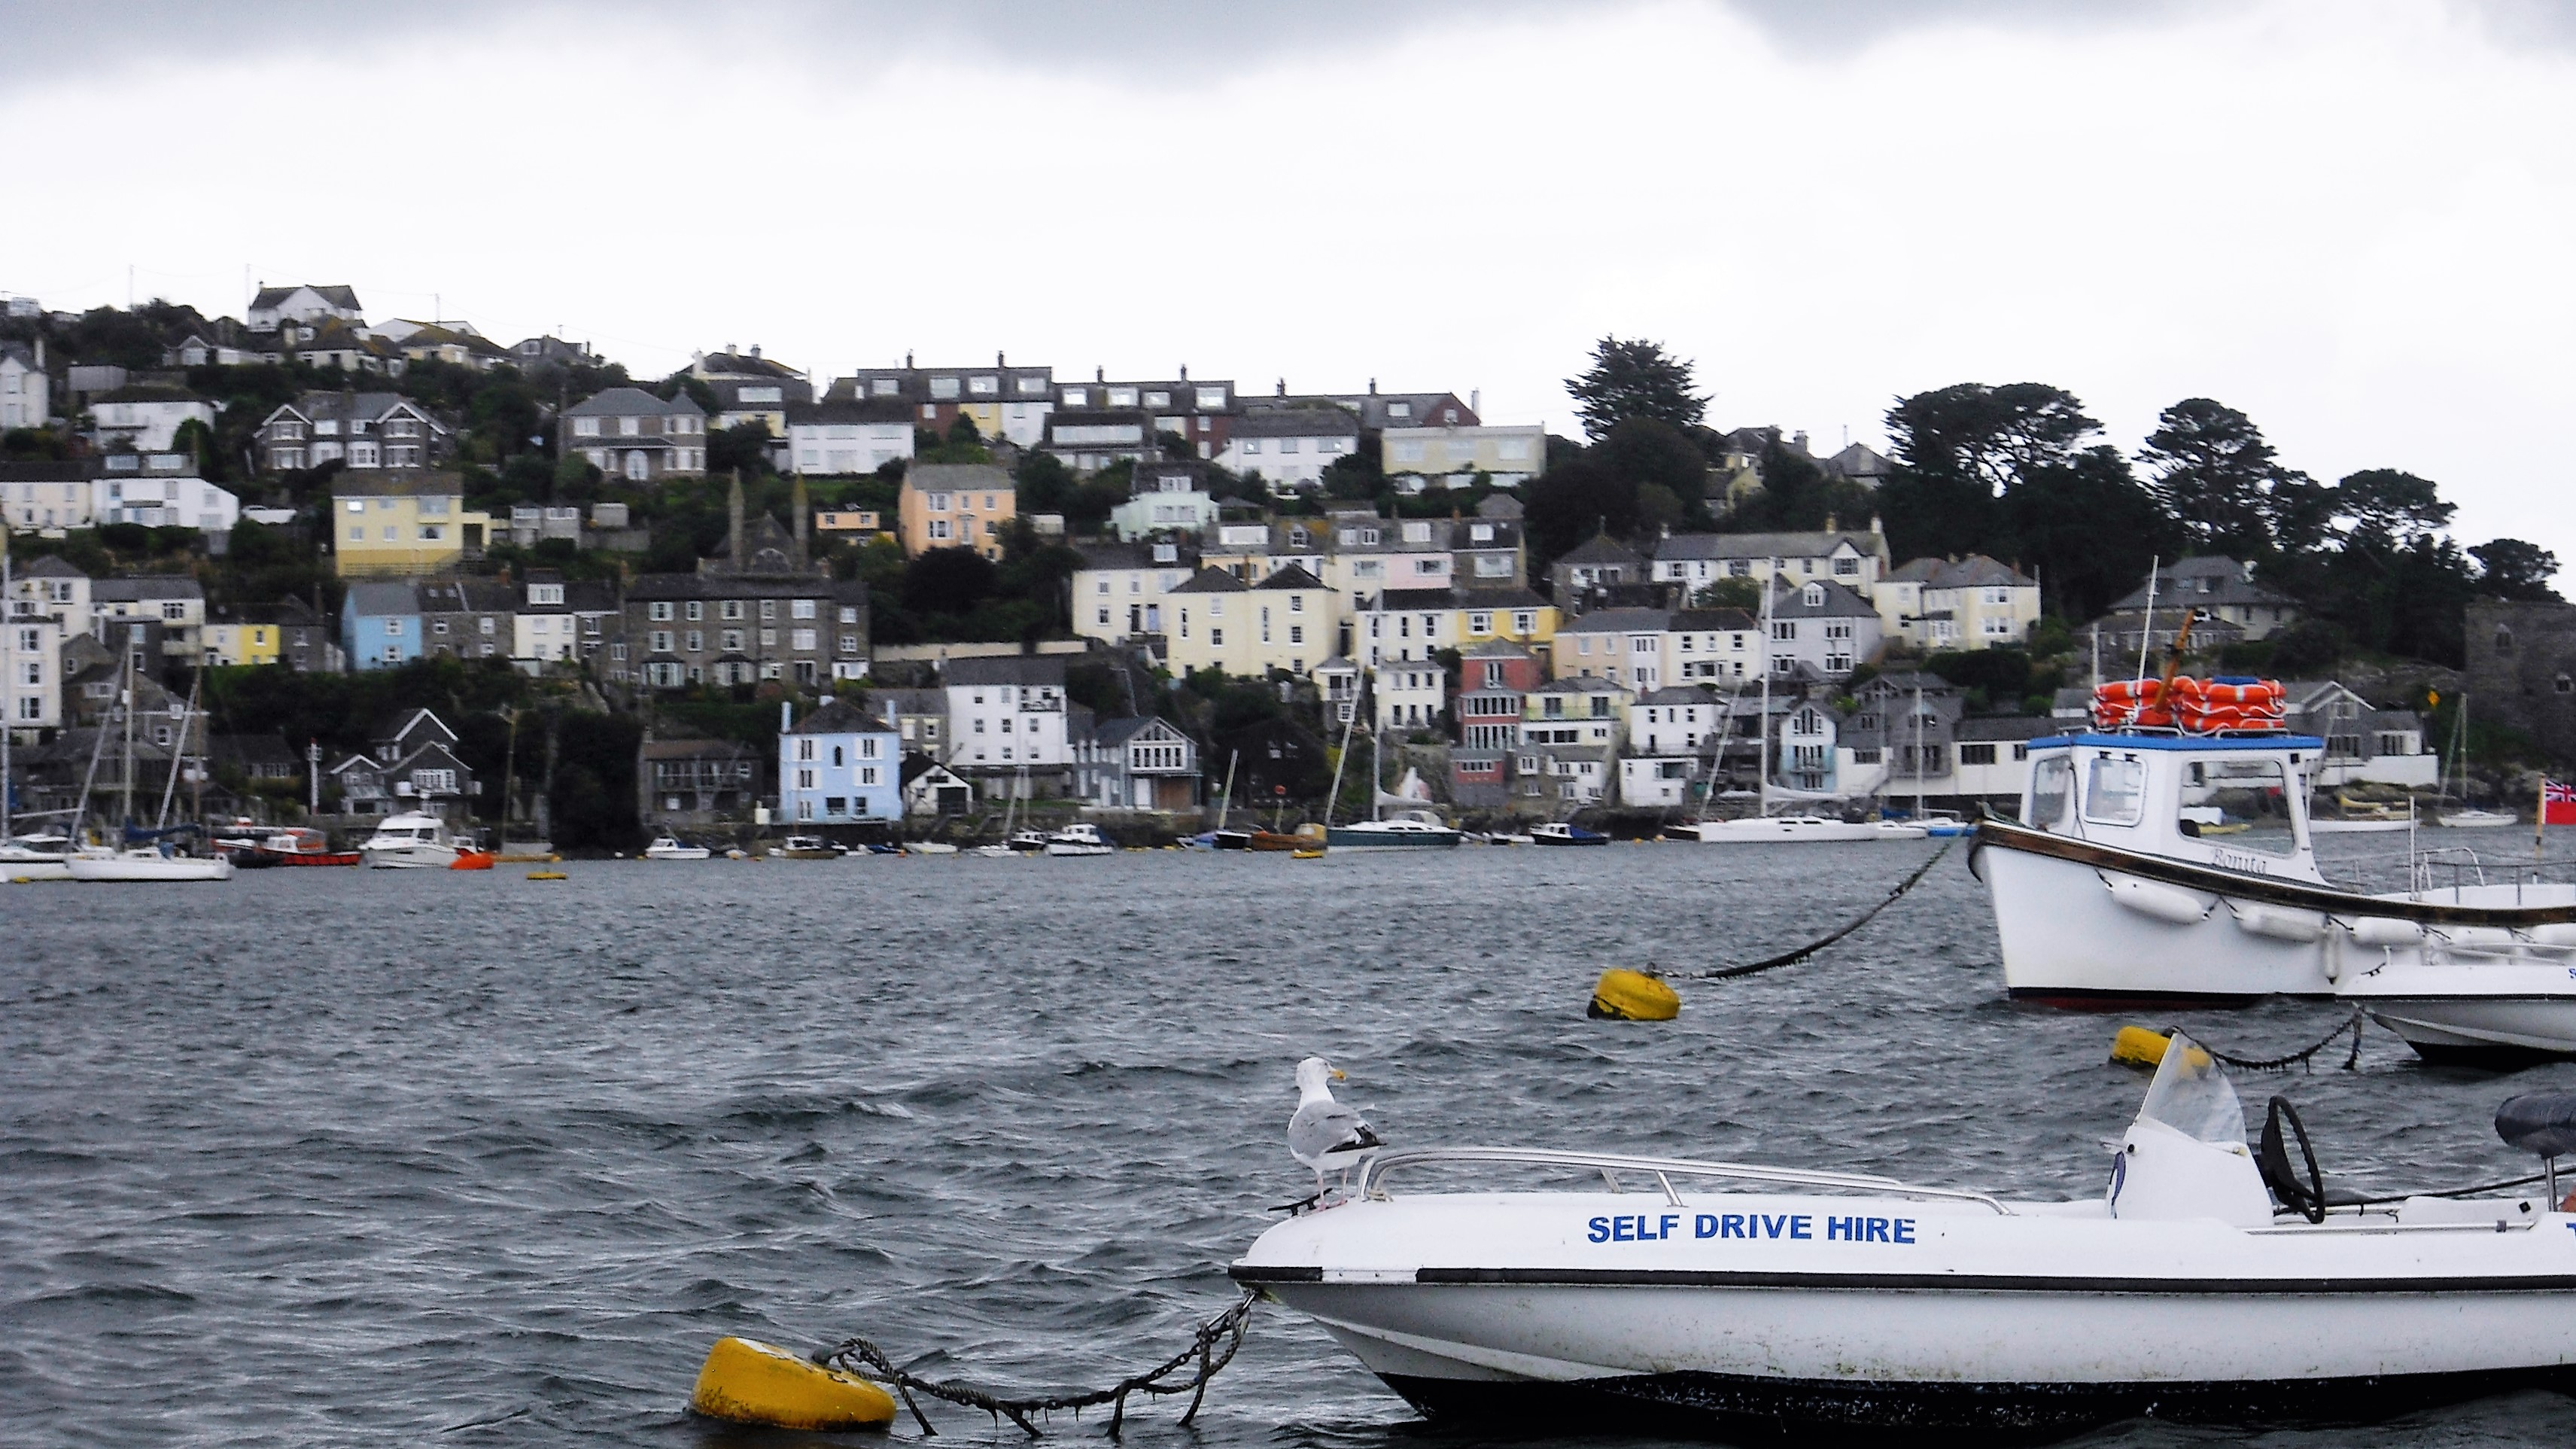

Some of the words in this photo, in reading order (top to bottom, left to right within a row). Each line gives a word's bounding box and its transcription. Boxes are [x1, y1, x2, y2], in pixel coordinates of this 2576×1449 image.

[2211, 848, 2267, 874] Bonita
[1587, 1213, 1680, 1244] SELF
[1695, 1213, 1812, 1240] DRIVE
[1827, 1216, 1916, 1244] HIRE
